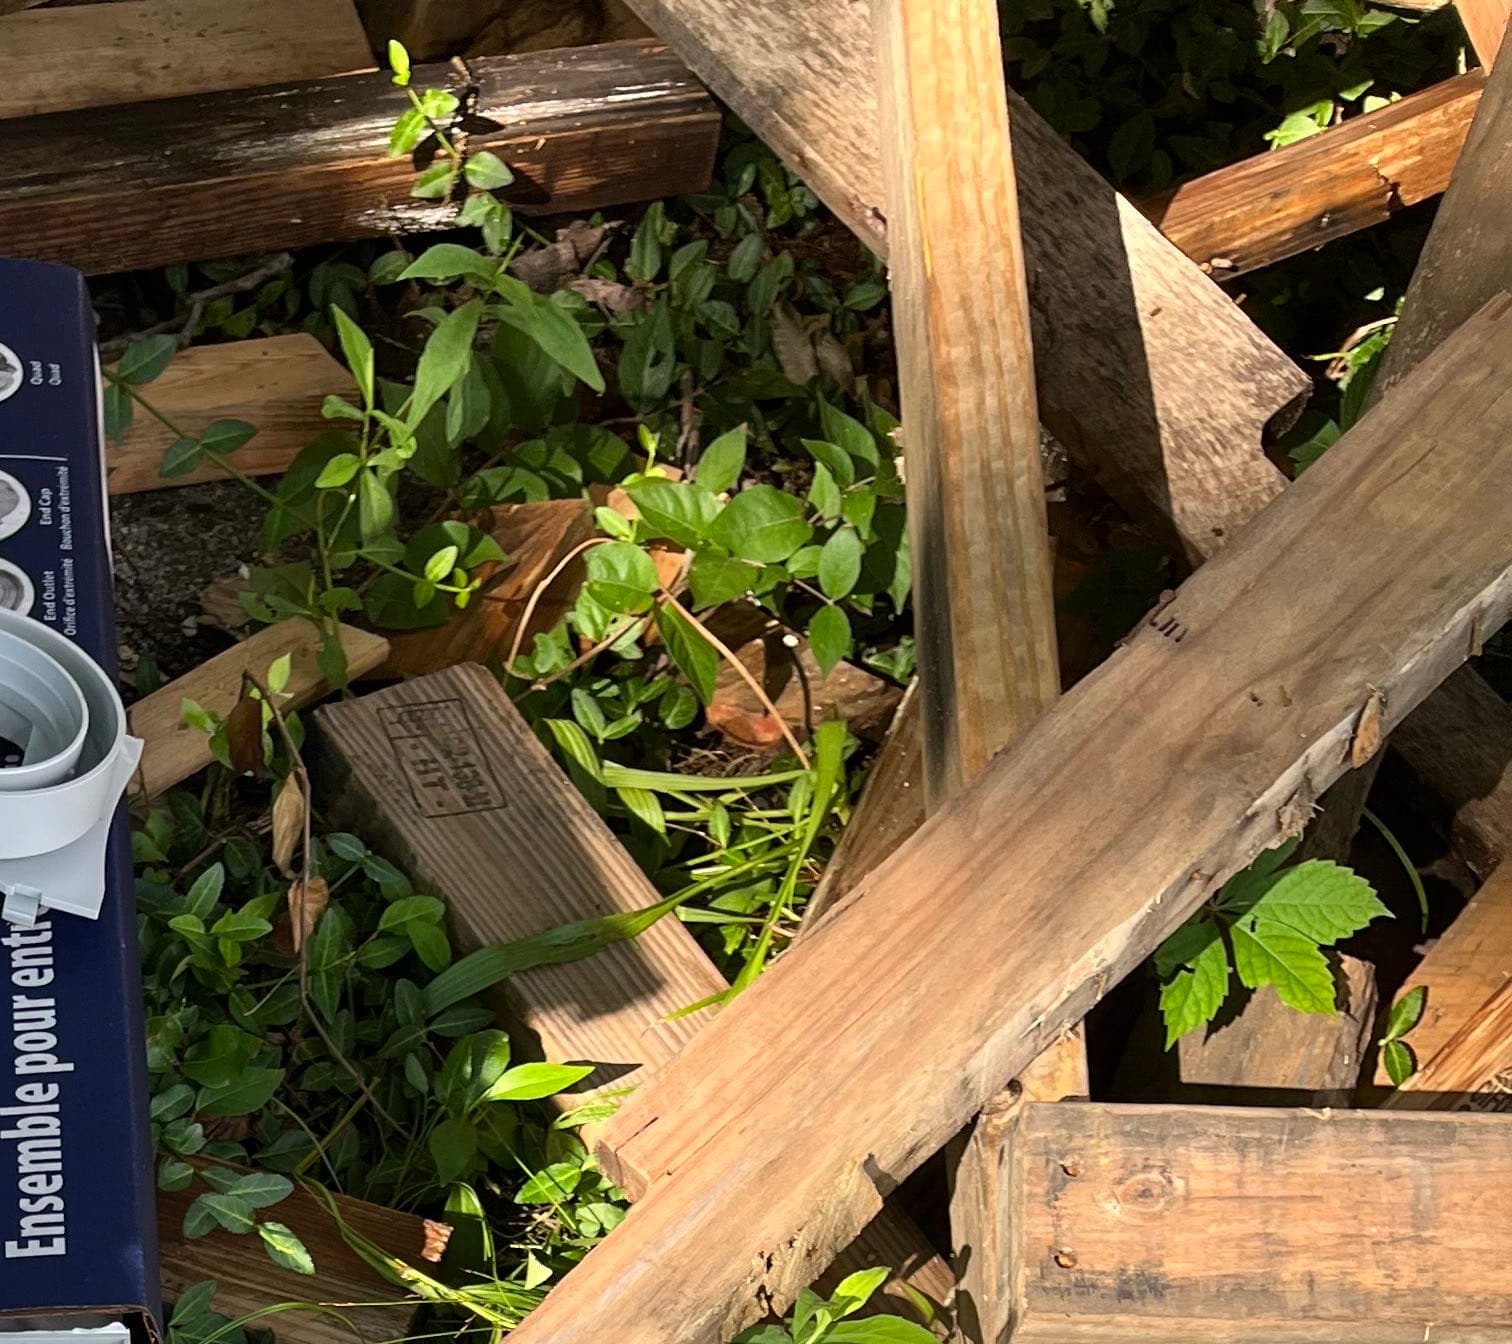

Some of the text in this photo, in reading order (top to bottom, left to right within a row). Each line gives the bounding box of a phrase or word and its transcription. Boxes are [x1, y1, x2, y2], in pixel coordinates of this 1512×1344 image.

[30, 361, 43, 385] Quad
[49, 364, 61, 385] Quad
[39, 488, 53, 524] End Cap
[59, 514, 72, 550] Bouchon
[42, 571, 56, 620] End Outlet
[63, 607, 76, 635] Orifice
[0, 905, 74, 1258] Ensemble pour entr
